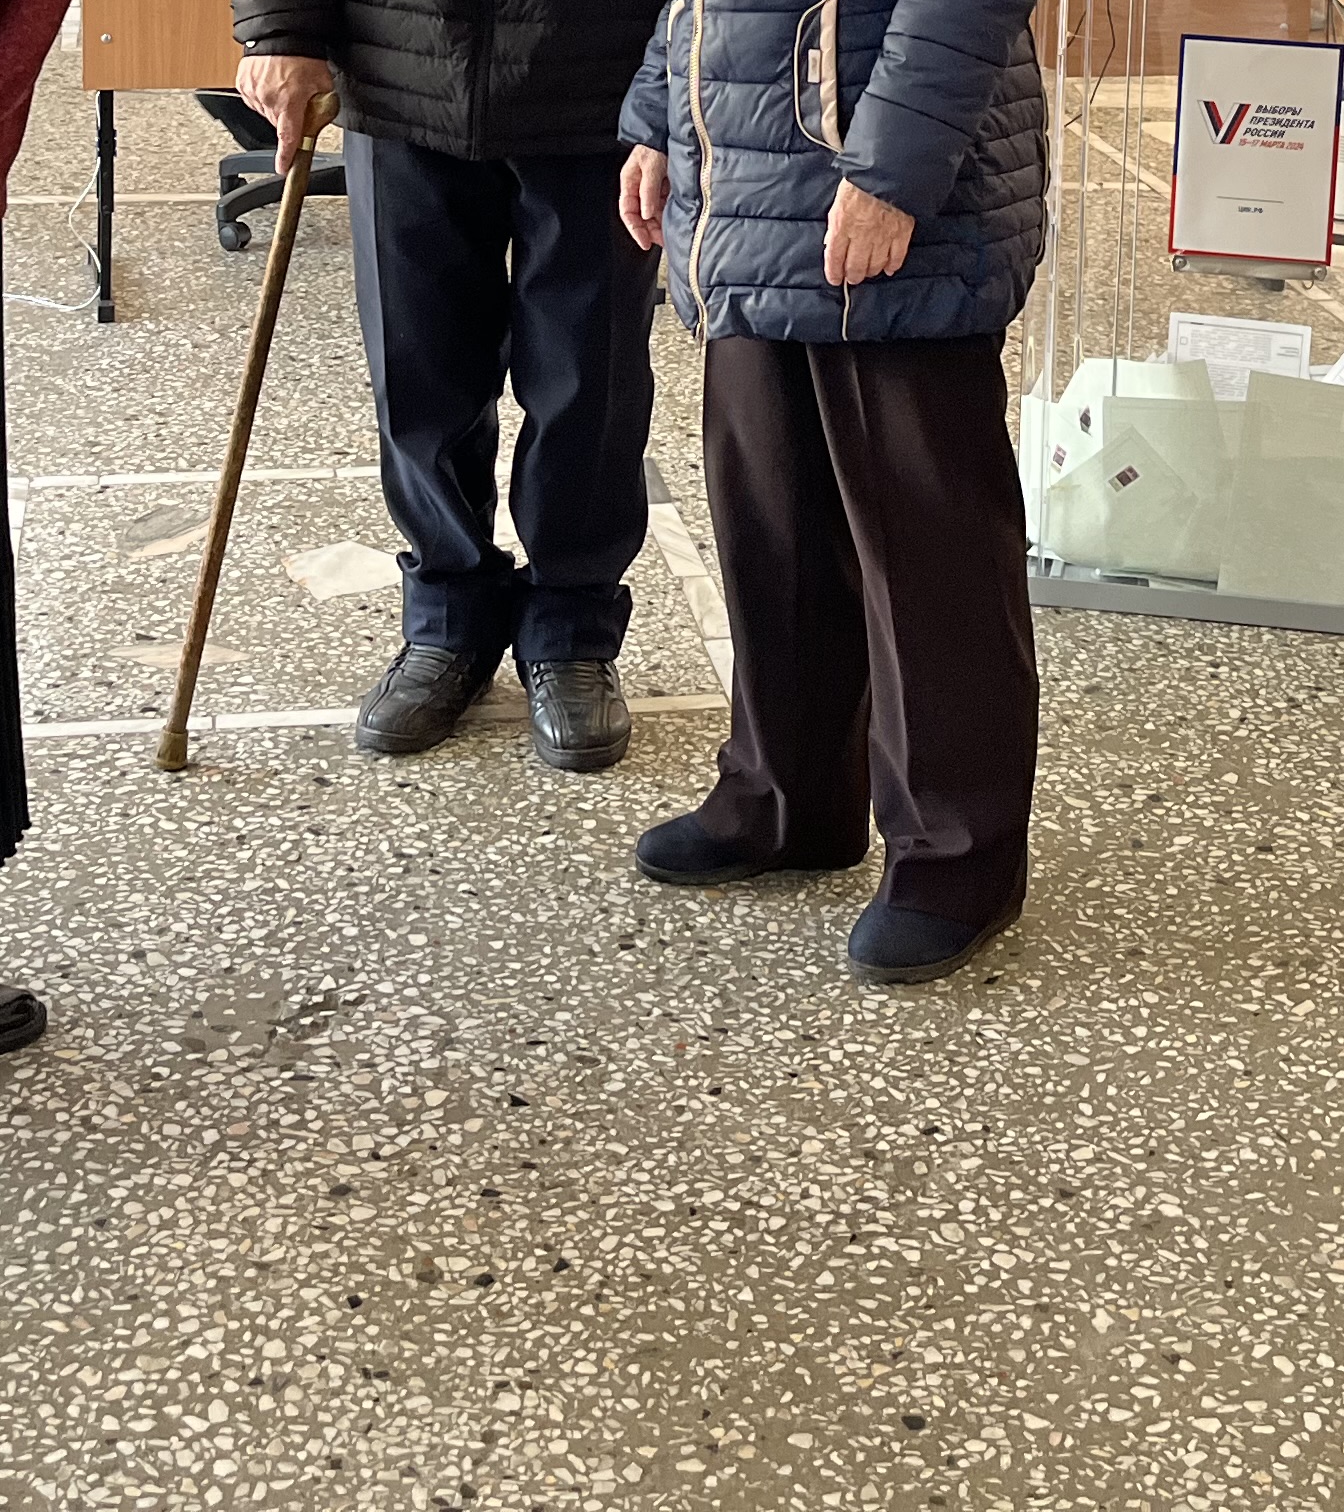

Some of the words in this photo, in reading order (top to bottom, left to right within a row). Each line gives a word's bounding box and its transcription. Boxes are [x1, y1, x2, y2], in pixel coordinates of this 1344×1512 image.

[1255, 104, 1302, 116] ВЫБОРЫ
[1249, 116, 1316, 129] ПРЕЗИДЕНТА
[1243, 127, 1286, 139] РОССИИ
[1259, 139, 1285, 149] МАРТА
